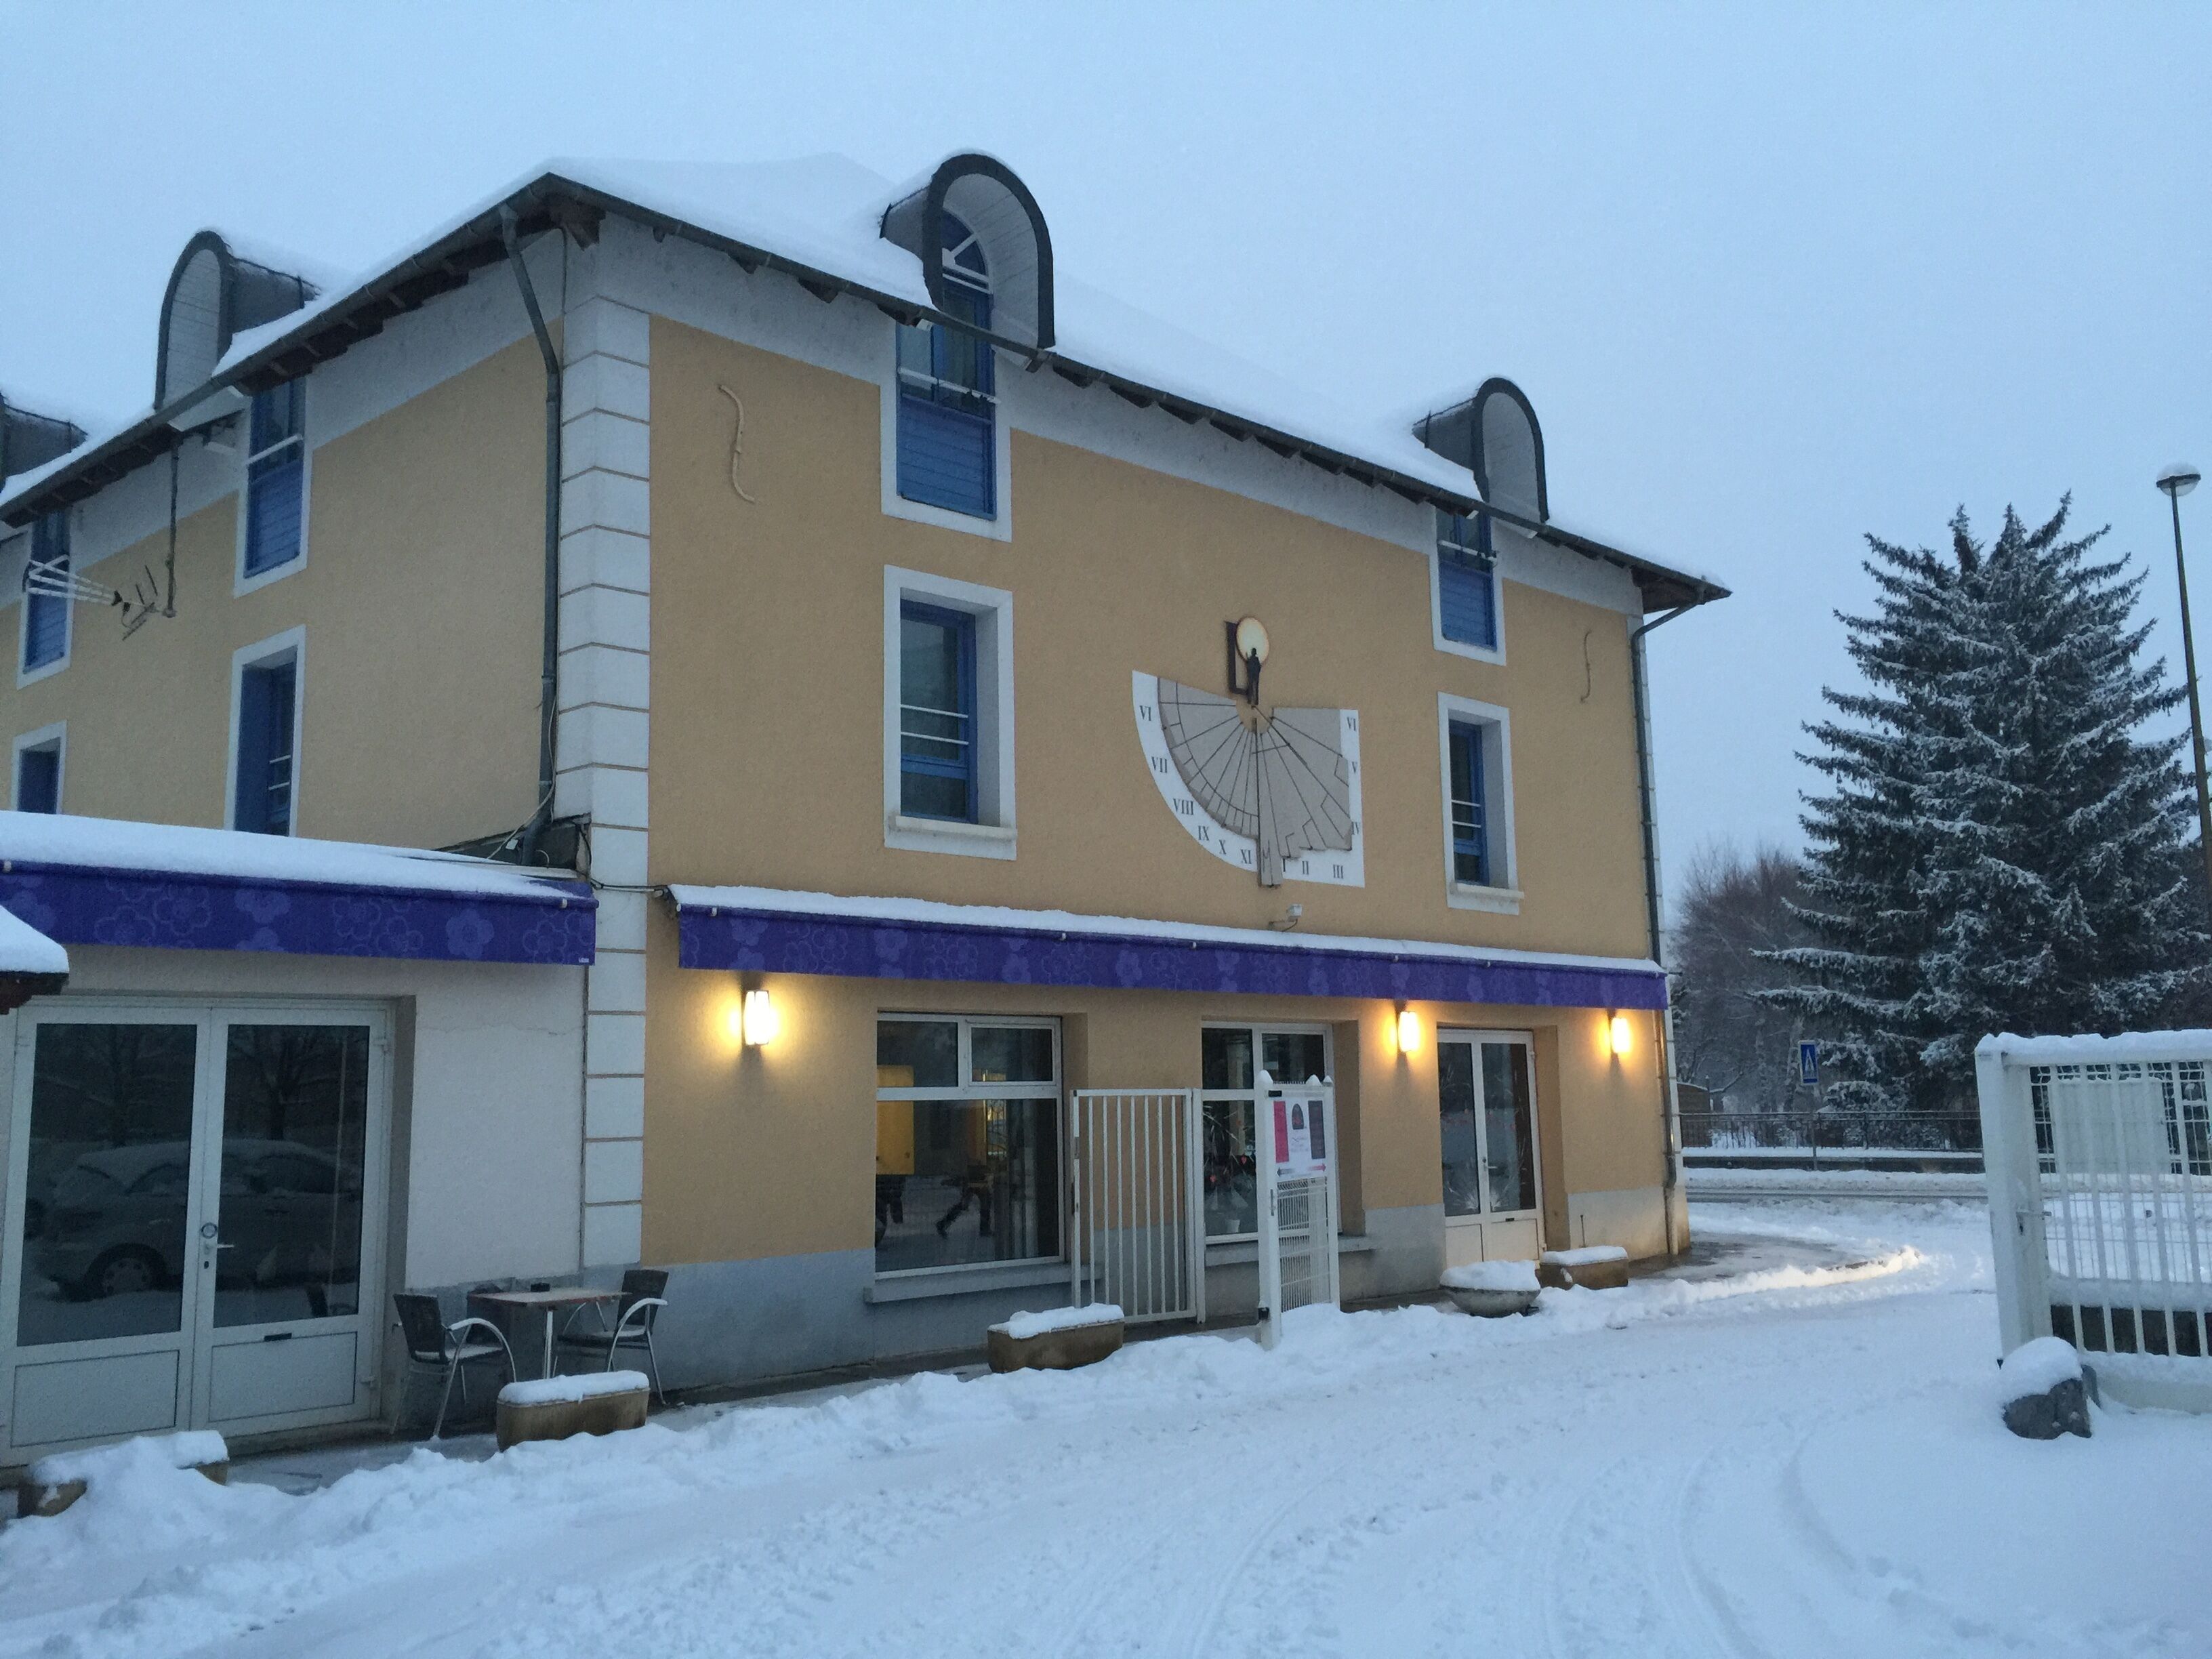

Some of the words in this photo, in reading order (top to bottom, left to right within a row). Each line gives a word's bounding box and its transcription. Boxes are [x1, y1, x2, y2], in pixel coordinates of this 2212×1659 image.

[1139, 705, 1151, 722] VI
[1151, 756, 1167, 773] VII
[1173, 798, 1193, 815] VIII
[1198, 825, 1209, 841] IX
[1218, 840, 1227, 855] X
[1240, 849, 1252, 864] XI
[1302, 861, 1309, 875] II
[1333, 864, 1344, 879] III
